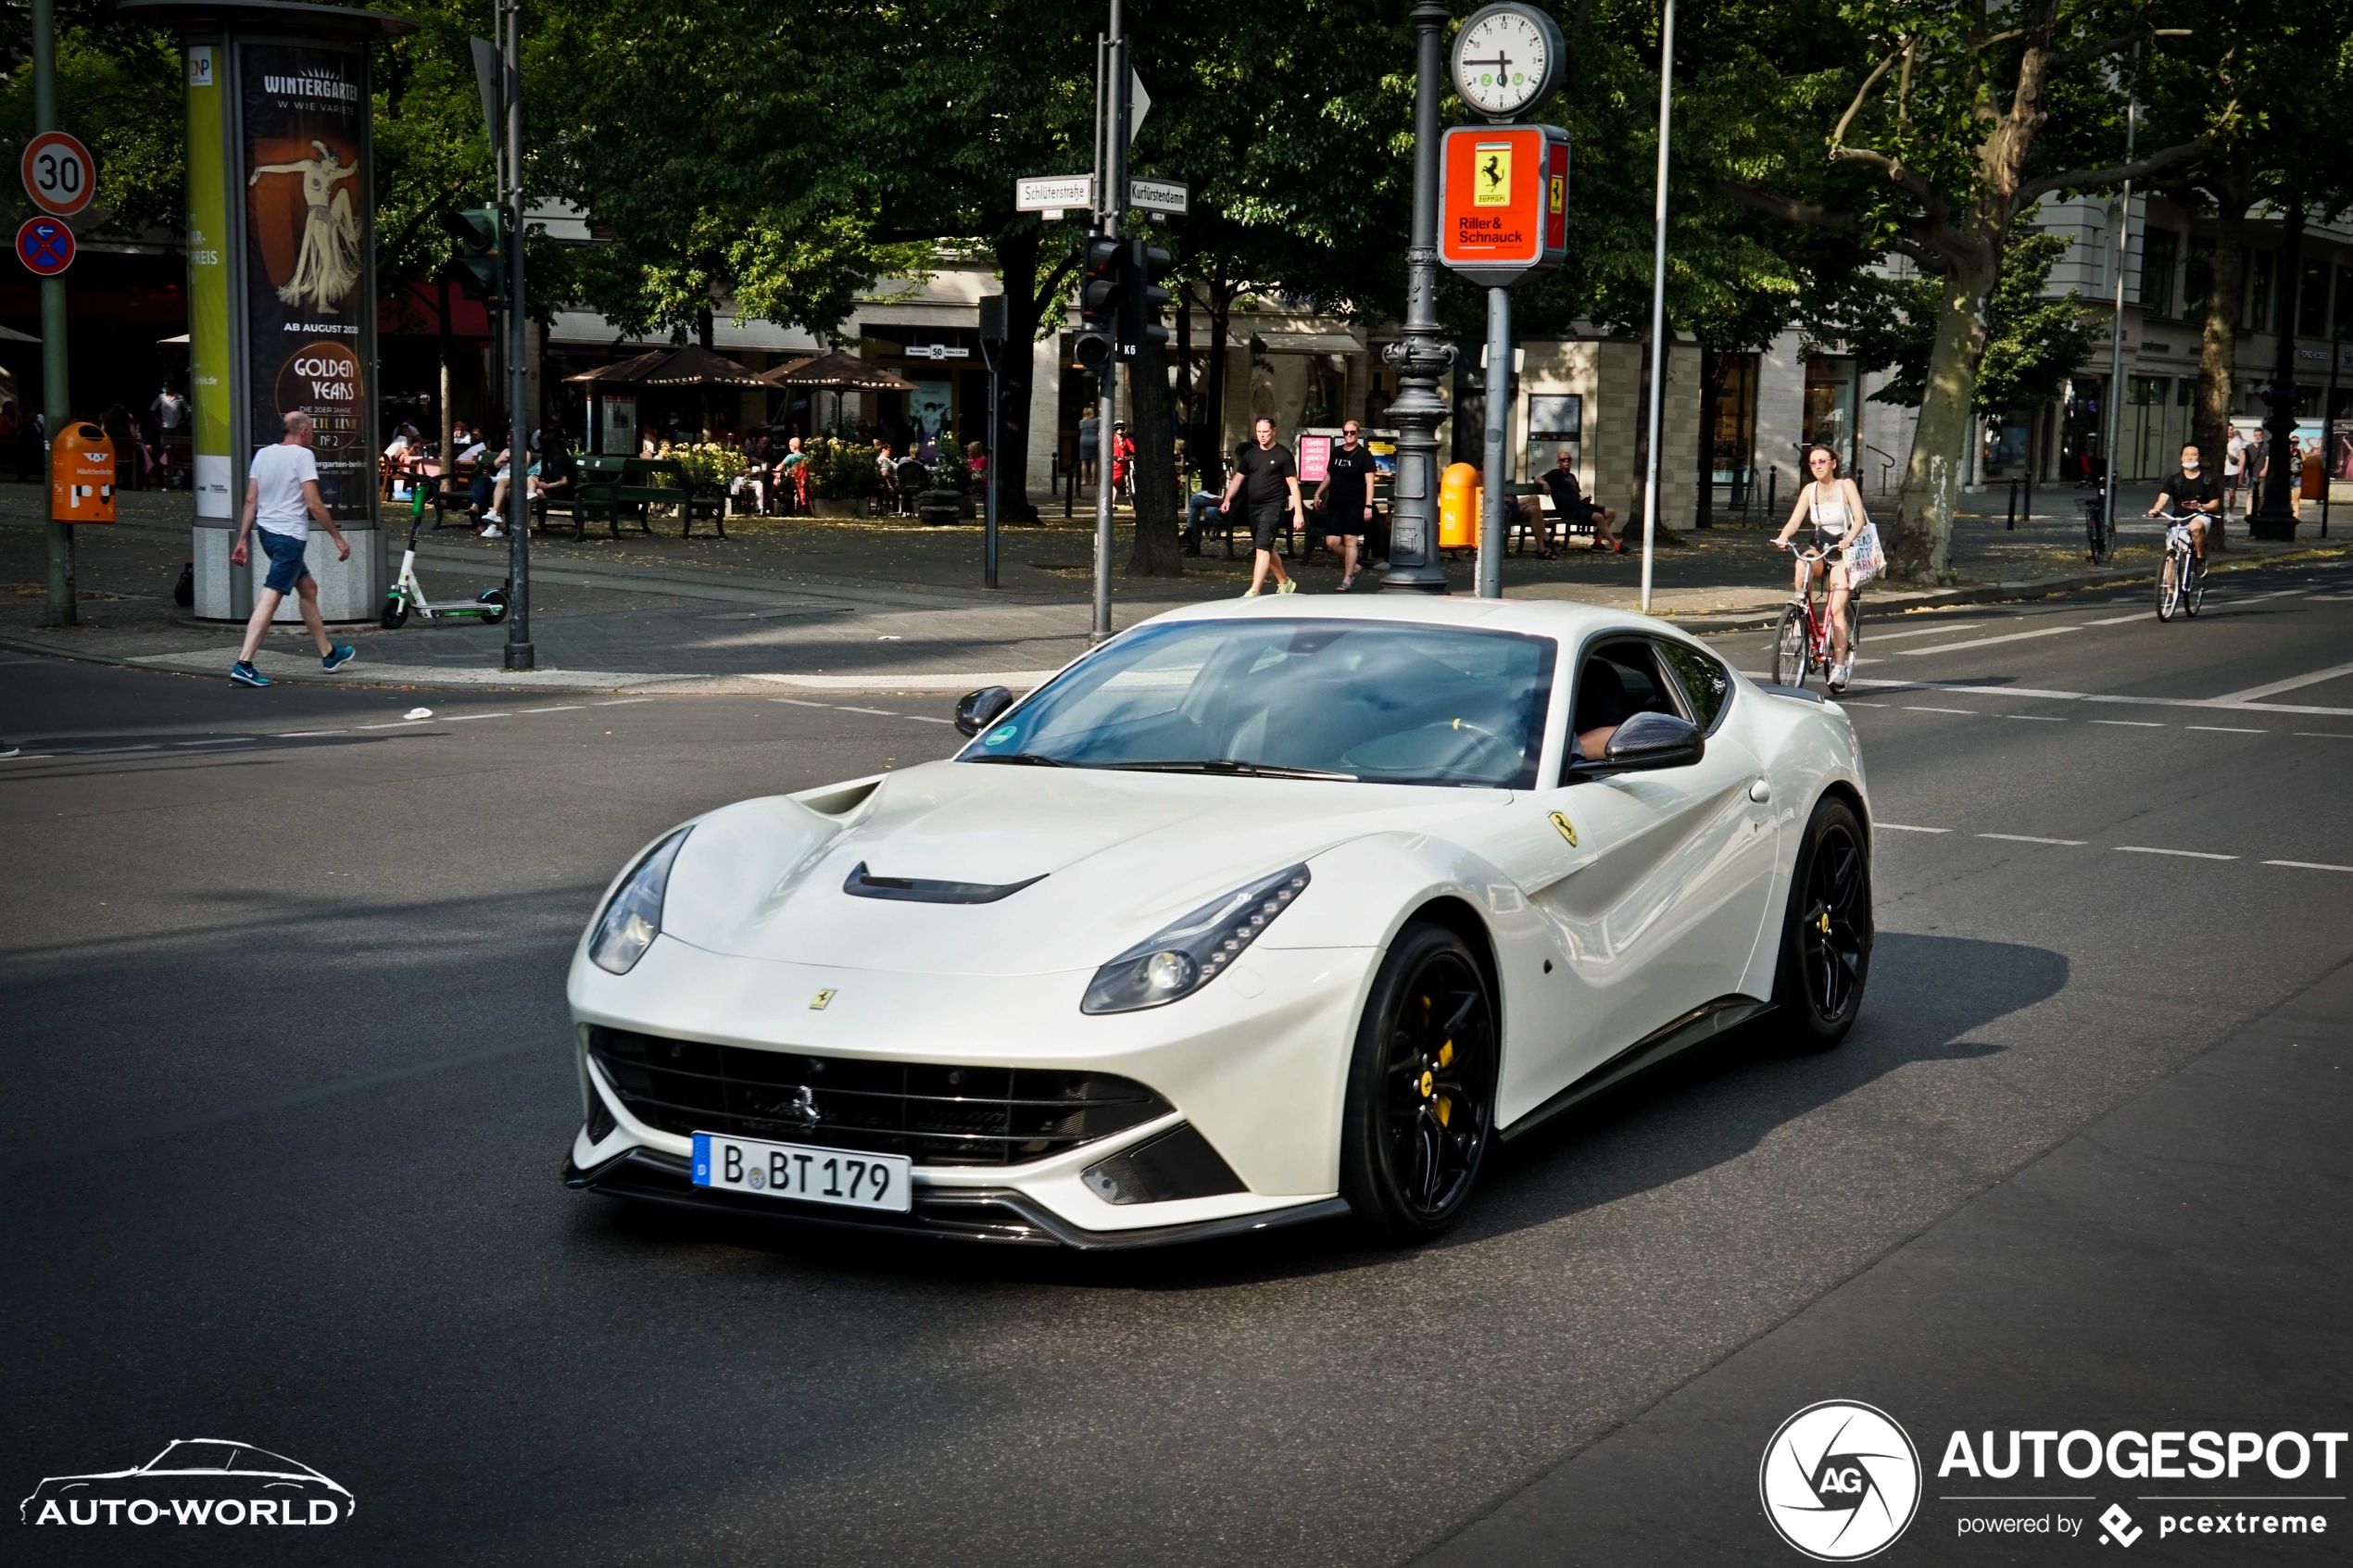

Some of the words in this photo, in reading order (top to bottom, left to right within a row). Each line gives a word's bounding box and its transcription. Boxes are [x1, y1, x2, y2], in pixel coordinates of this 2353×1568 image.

[1473, 41, 1480, 49] 10
[264, 76, 359, 102] WINTERGARTEN
[277, 100, 289, 108] W
[294, 101, 316, 111] WIE
[38, 154, 79, 194] 30
[1025, 183, 1085, 201] Schlüterstraße
[1131, 183, 1185, 206] Kurfürstendamm
[1478, 194, 1505, 203] Ferrari
[1459, 231, 1522, 243] Schnauck
[283, 322, 300, 332] AB
[302, 323, 342, 333] AUGUST
[343, 325, 359, 334] 2020
[1124, 345, 1137, 356] K6
[294, 358, 354, 378] GOLDEN
[647, 375, 702, 384] EINSTEIN
[713, 376, 765, 385] KAFFEE
[851, 380, 901, 388] KAFFEE
[311, 381, 354, 400] YEARS
[724, 1145, 744, 1184] B
[770, 1150, 813, 1193] BT
[823, 1158, 889, 1202] 179
